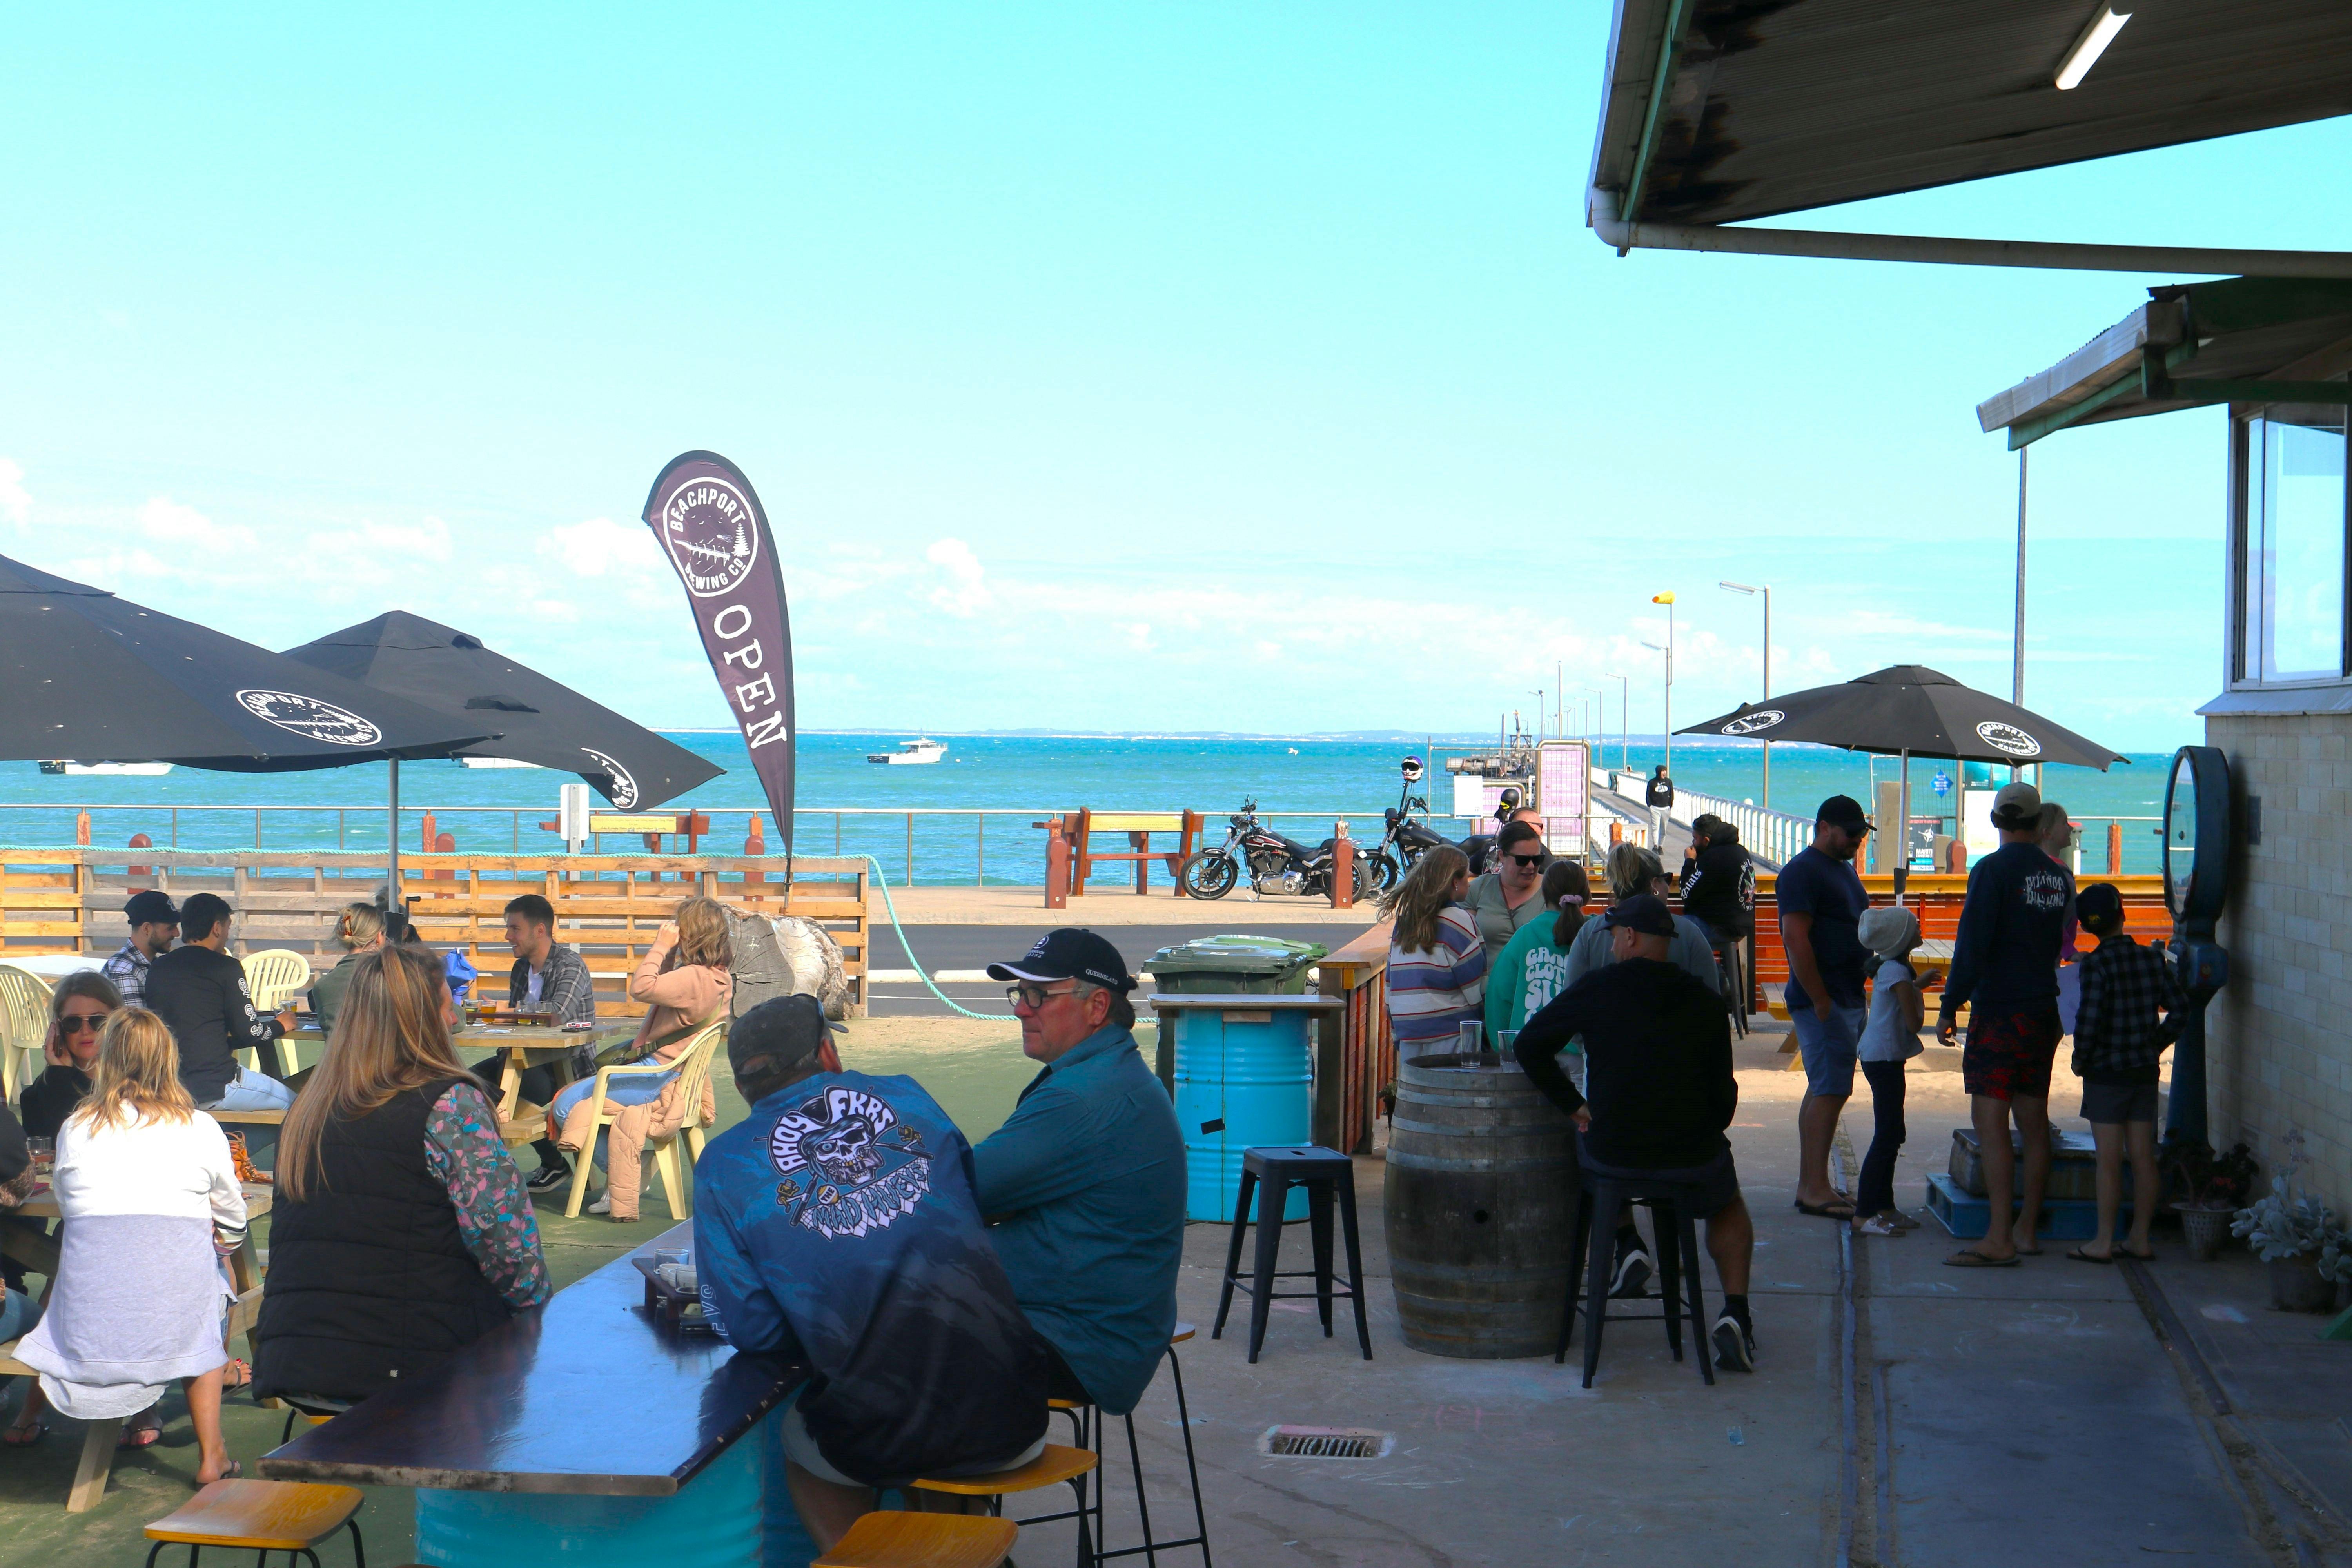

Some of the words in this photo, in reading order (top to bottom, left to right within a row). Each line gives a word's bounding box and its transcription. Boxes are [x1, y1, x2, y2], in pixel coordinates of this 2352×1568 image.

[670, 488, 746, 532] BEACHPORT
[714, 604, 787, 749] OPEN
[246, 693, 321, 717] BEACHPORT
[313, 730, 373, 743] BREWING
[1085, 969, 1118, 985] QUEENSLAND
[772, 1115, 826, 1171] AHOY
[830, 1089, 894, 1136] FKRS
[821, 1187, 835, 1202] THE
